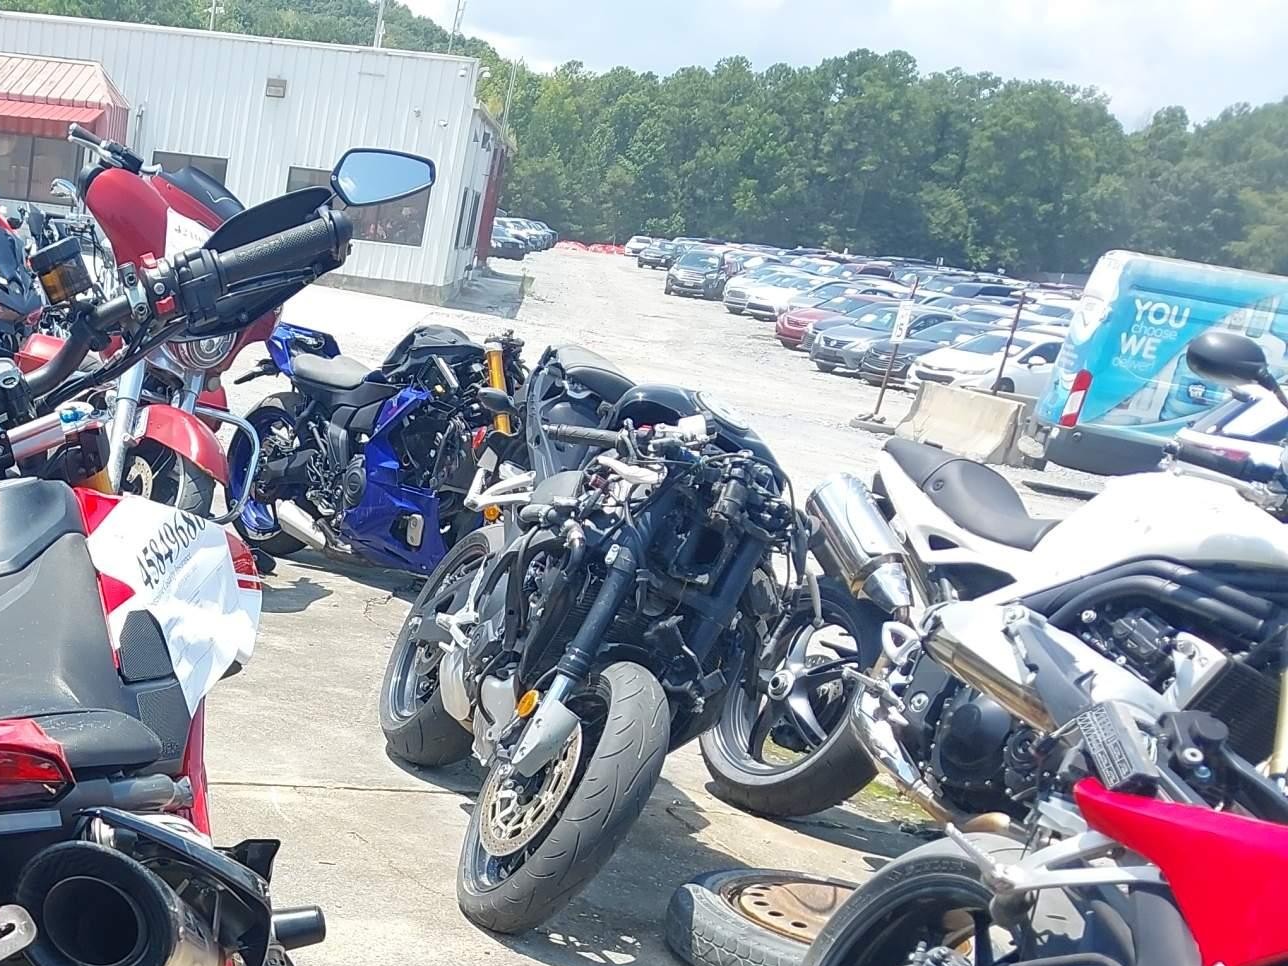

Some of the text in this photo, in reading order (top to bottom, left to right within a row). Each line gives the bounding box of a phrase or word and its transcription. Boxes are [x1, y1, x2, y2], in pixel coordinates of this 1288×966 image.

[1135, 298, 1191, 329] YOU
[1120, 331, 1162, 360] WE
[1131, 321, 1178, 341] choose
